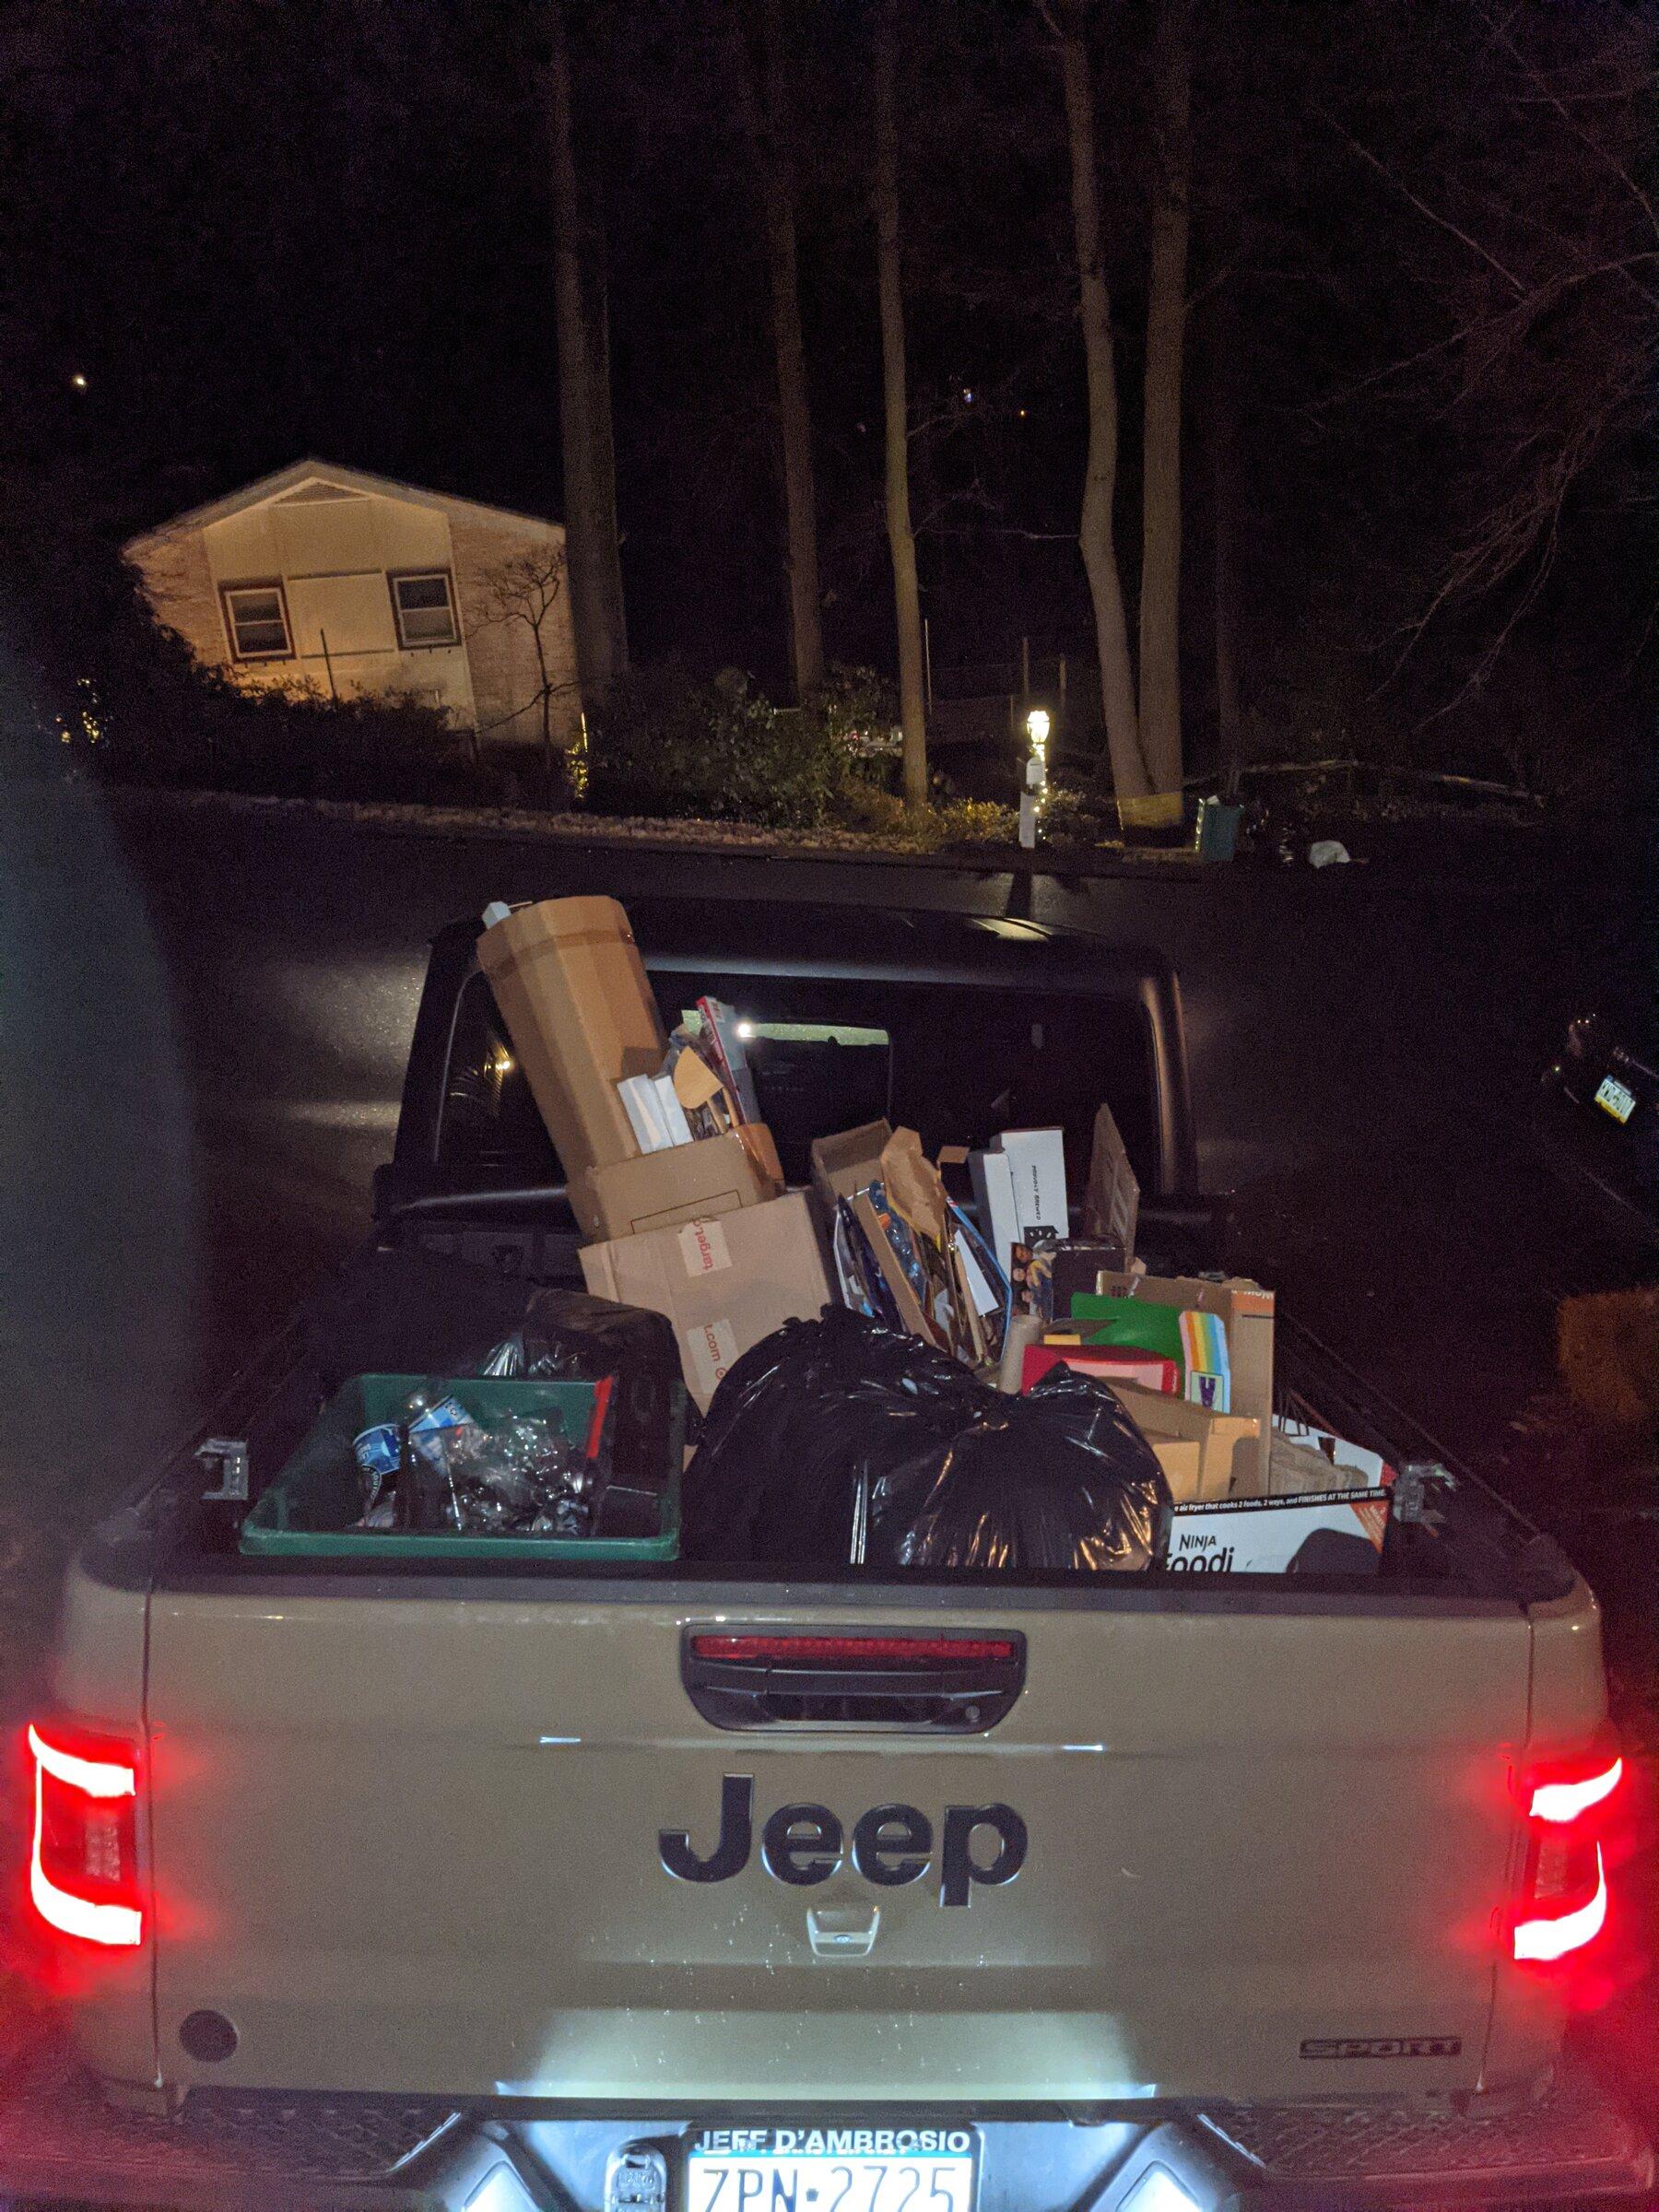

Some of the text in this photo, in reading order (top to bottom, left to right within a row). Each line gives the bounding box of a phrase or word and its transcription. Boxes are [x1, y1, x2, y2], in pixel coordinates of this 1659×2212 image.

[1188, 1503, 1205, 1512] fryer
[1298, 1494, 1327, 1503] FINISHES
[1337, 1491, 1349, 1500] THE
[1350, 1490, 1368, 1499] SAME
[1179, 1534, 1217, 1552] NINJA
[658, 1773, 1029, 1908] Jeep
[695, 2130, 971, 2153] JEFF D'AMBROSIO
